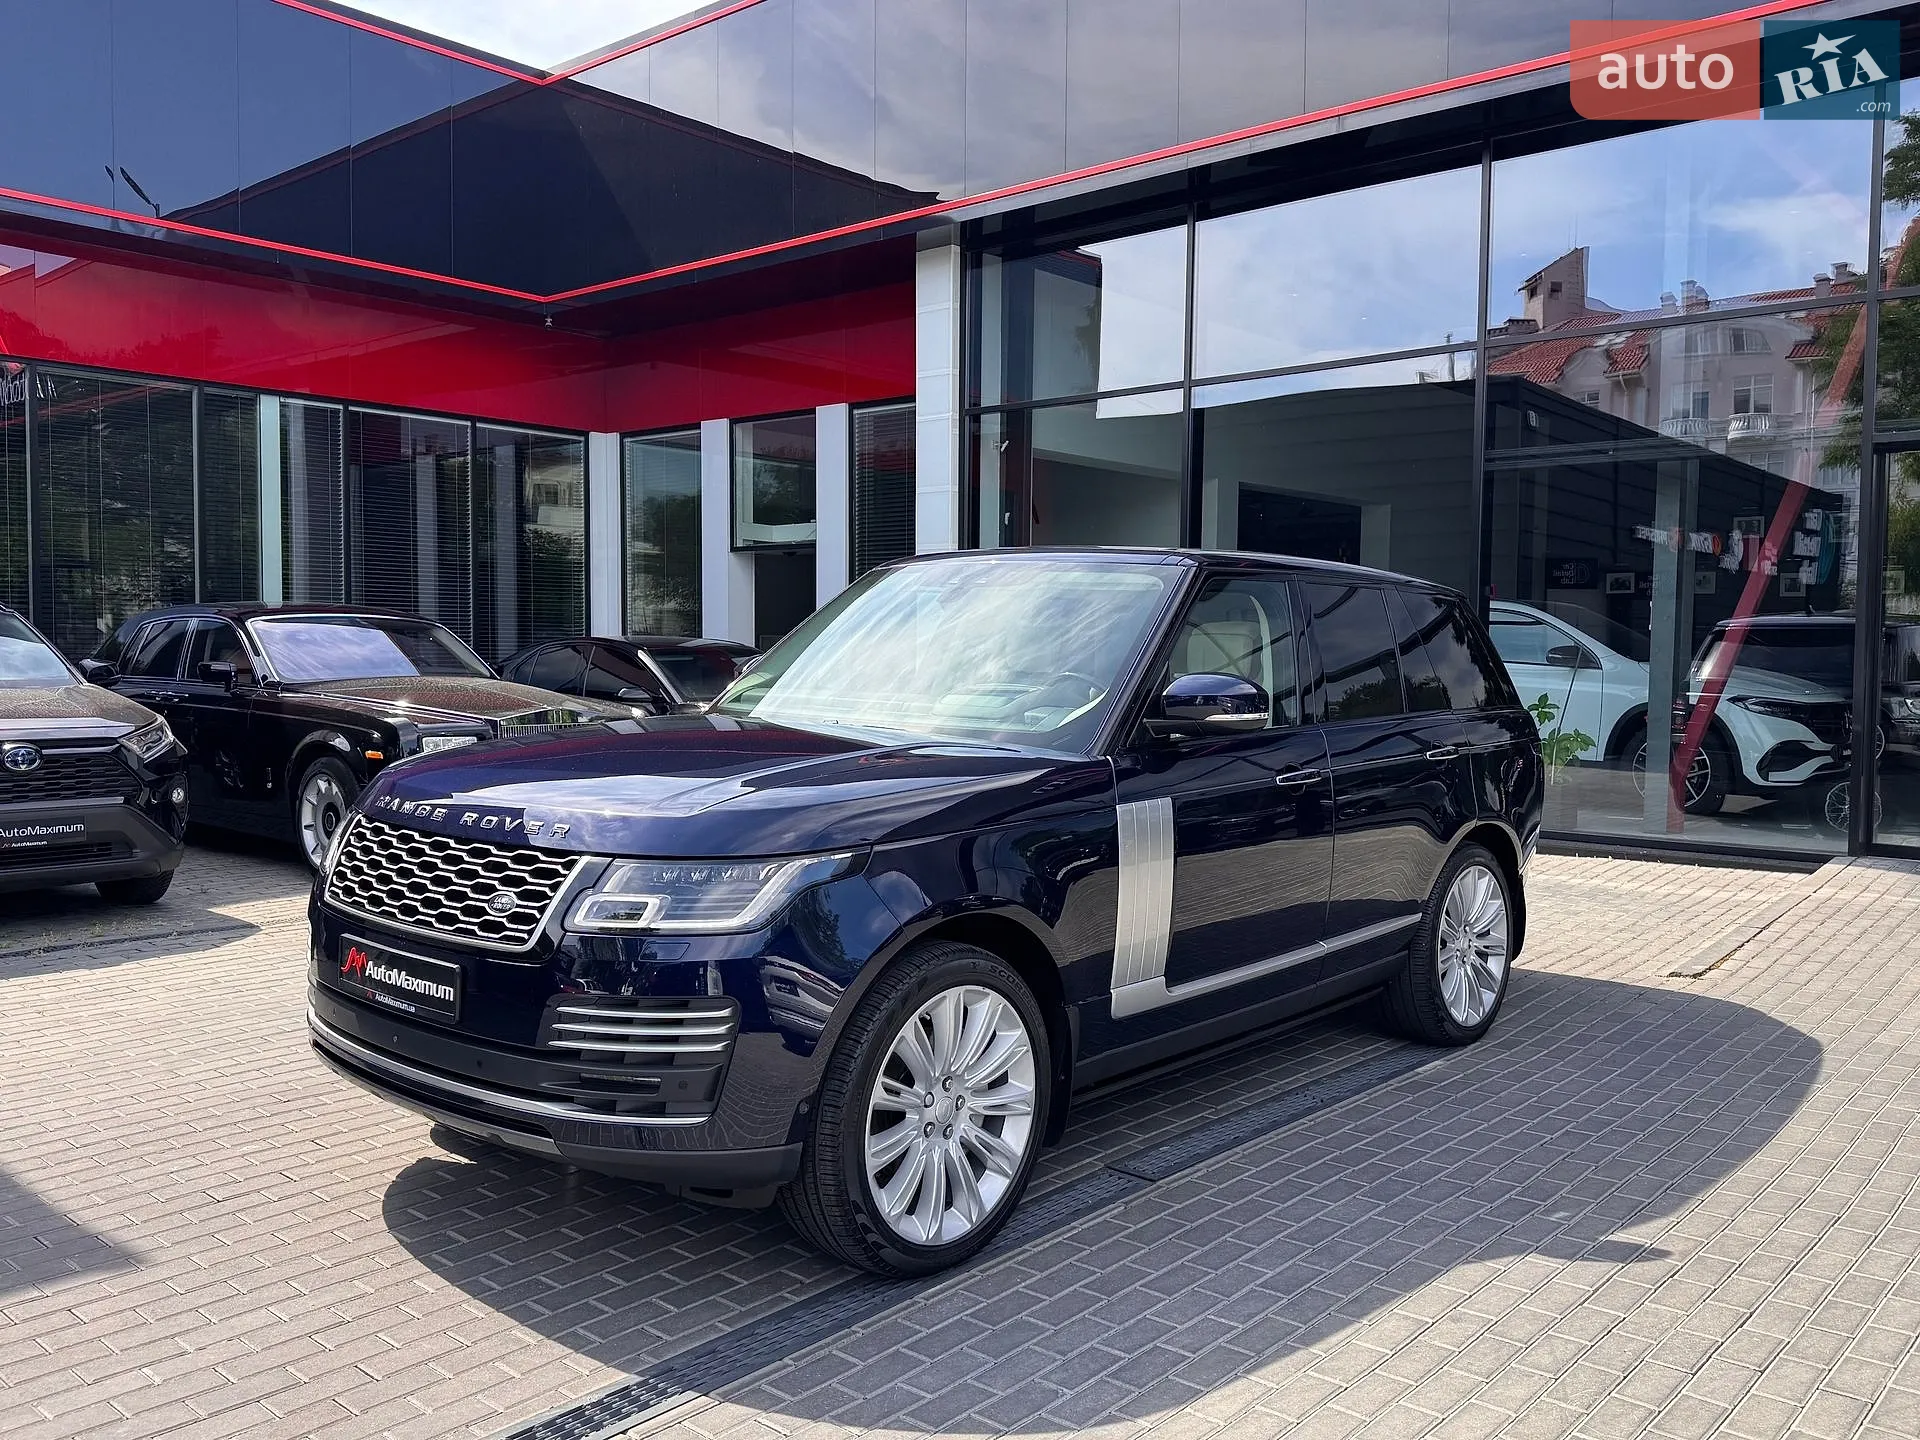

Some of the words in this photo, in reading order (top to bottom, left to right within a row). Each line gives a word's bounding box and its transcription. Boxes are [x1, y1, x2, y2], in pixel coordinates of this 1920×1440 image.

[0, 824, 84, 838] AutoMaximum
[375, 796, 448, 822] RANGE
[459, 811, 570, 838] ROVER
[365, 960, 454, 1002] AutoMaximum
